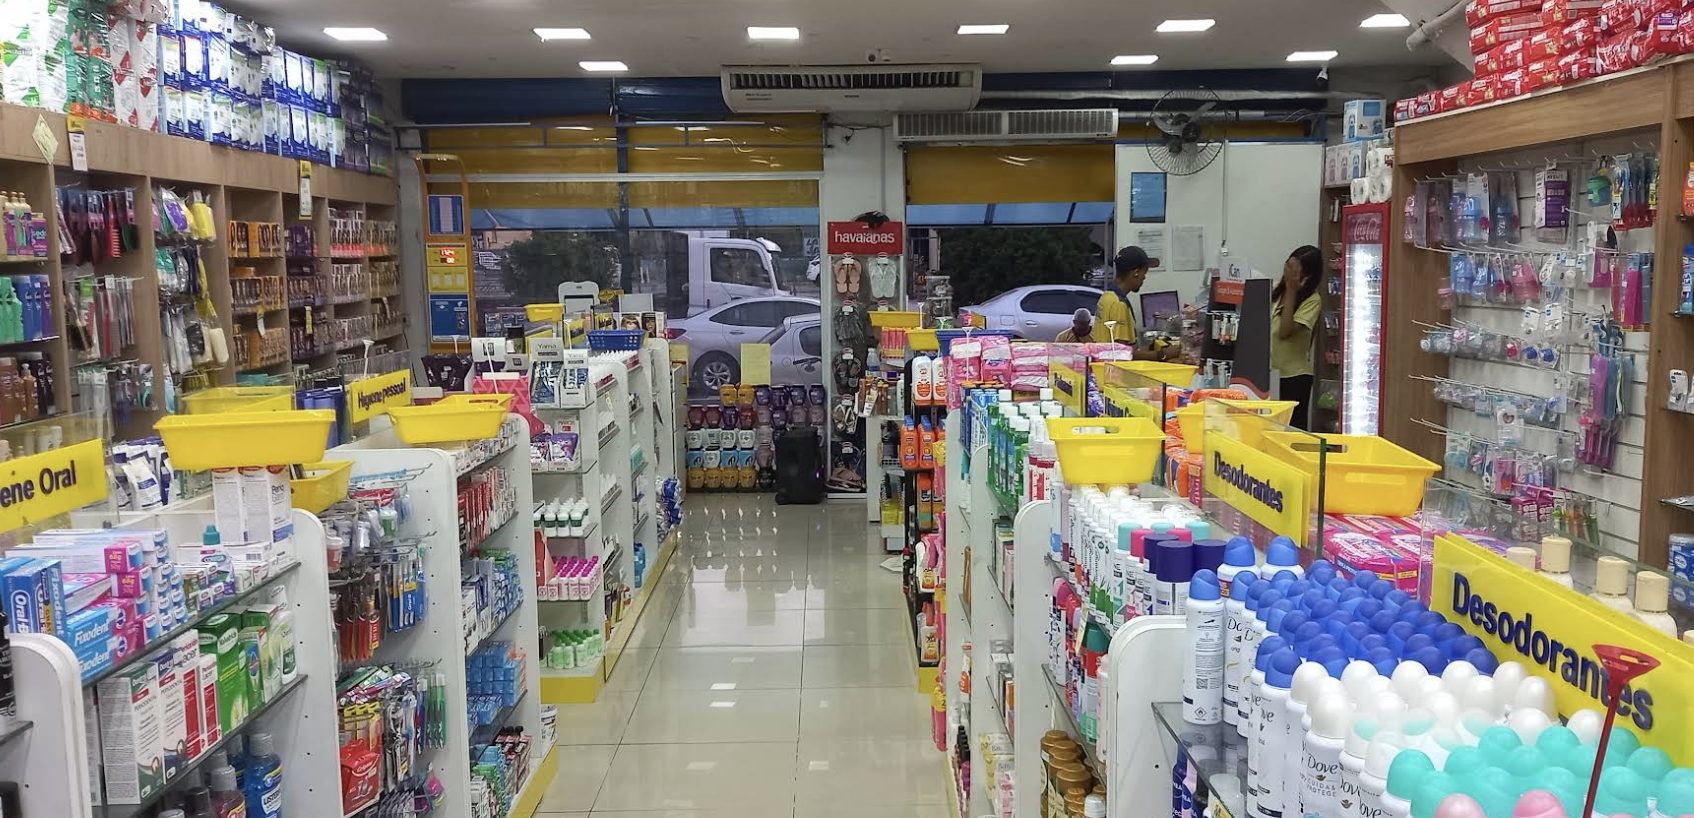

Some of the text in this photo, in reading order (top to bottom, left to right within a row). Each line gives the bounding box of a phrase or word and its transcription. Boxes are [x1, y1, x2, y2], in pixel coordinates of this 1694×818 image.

[835, 231, 894, 244] havaianas
[357, 378, 407, 411] Higiene pessoal
[0, 460, 77, 508] ene Oral
[1214, 450, 1284, 514] Desodorantes
[14, 594, 30, 634] Oral-B
[51, 567, 65, 636] Fixodent
[74, 621, 111, 648] Fixodent
[1453, 571, 1654, 731] Desodorantes
[78, 650, 112, 676] Fixodent
[1307, 753, 1339, 775] Dove
[1306, 783, 1338, 798] PROTEGE
